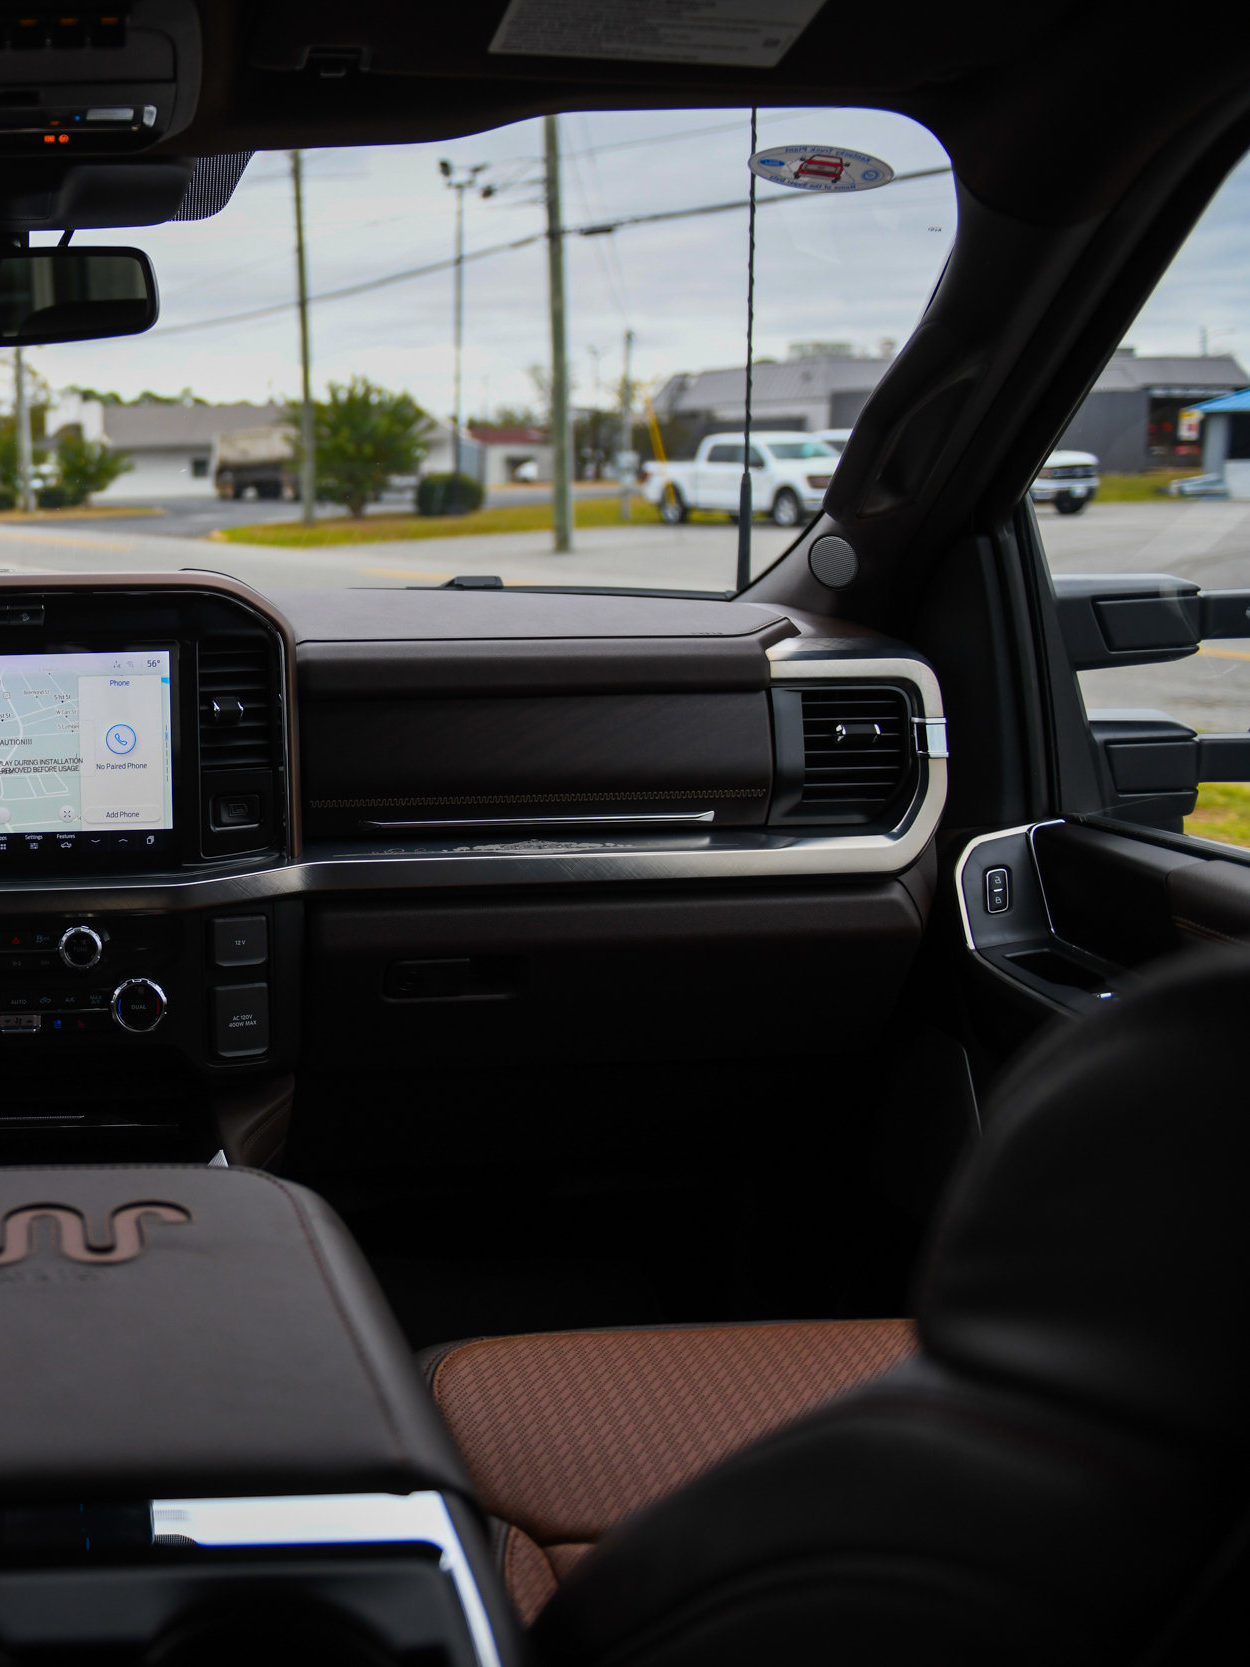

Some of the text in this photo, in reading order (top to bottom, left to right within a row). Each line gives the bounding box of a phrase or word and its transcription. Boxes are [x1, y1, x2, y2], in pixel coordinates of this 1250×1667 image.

[147, 659, 161, 668] 56°
[109, 679, 131, 687] Phone
[39, 757, 83, 765] INSTALLATION
[106, 762, 126, 770] Paired
[106, 811, 119, 819] Add
